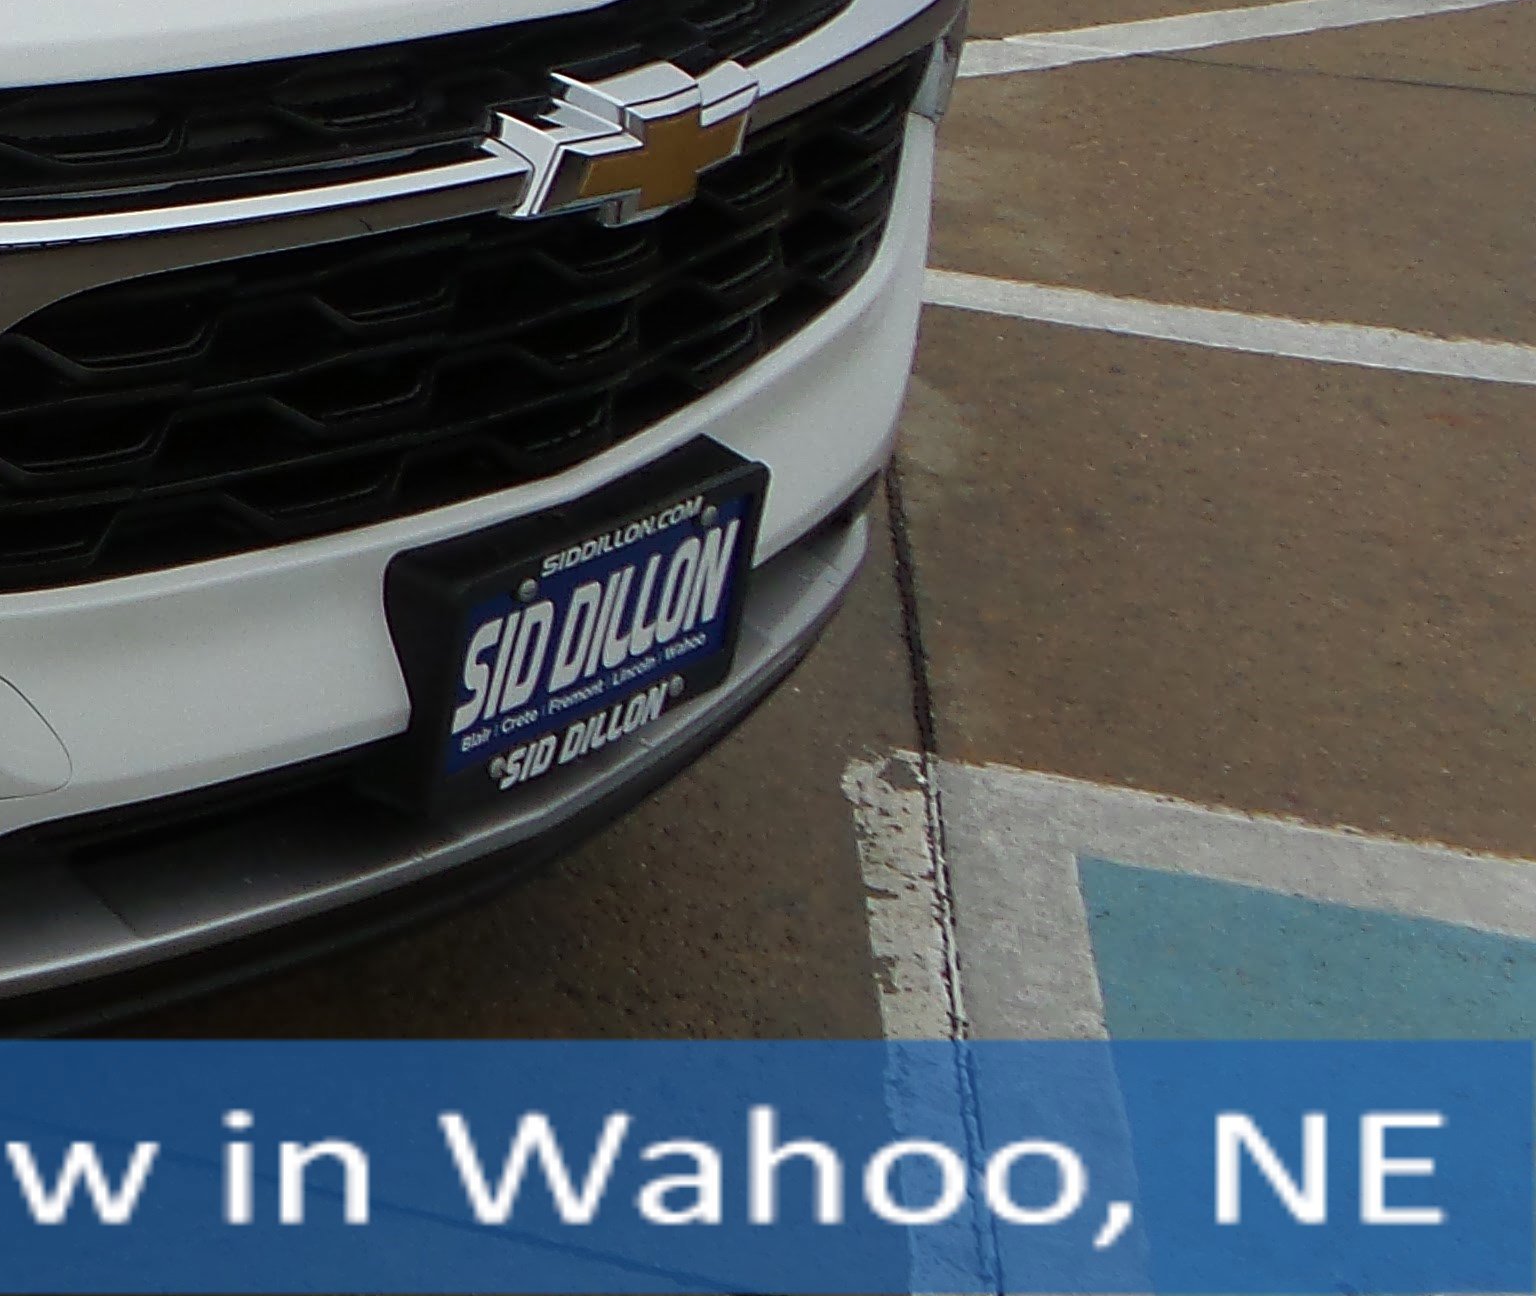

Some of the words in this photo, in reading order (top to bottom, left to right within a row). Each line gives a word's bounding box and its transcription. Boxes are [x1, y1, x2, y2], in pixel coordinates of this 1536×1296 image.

[542, 496, 704, 577] SIDDILLON.COM
[451, 600, 555, 735] SID
[548, 519, 740, 693] DILLON
[499, 734, 557, 790] SID
[558, 684, 669, 765] DILLON
